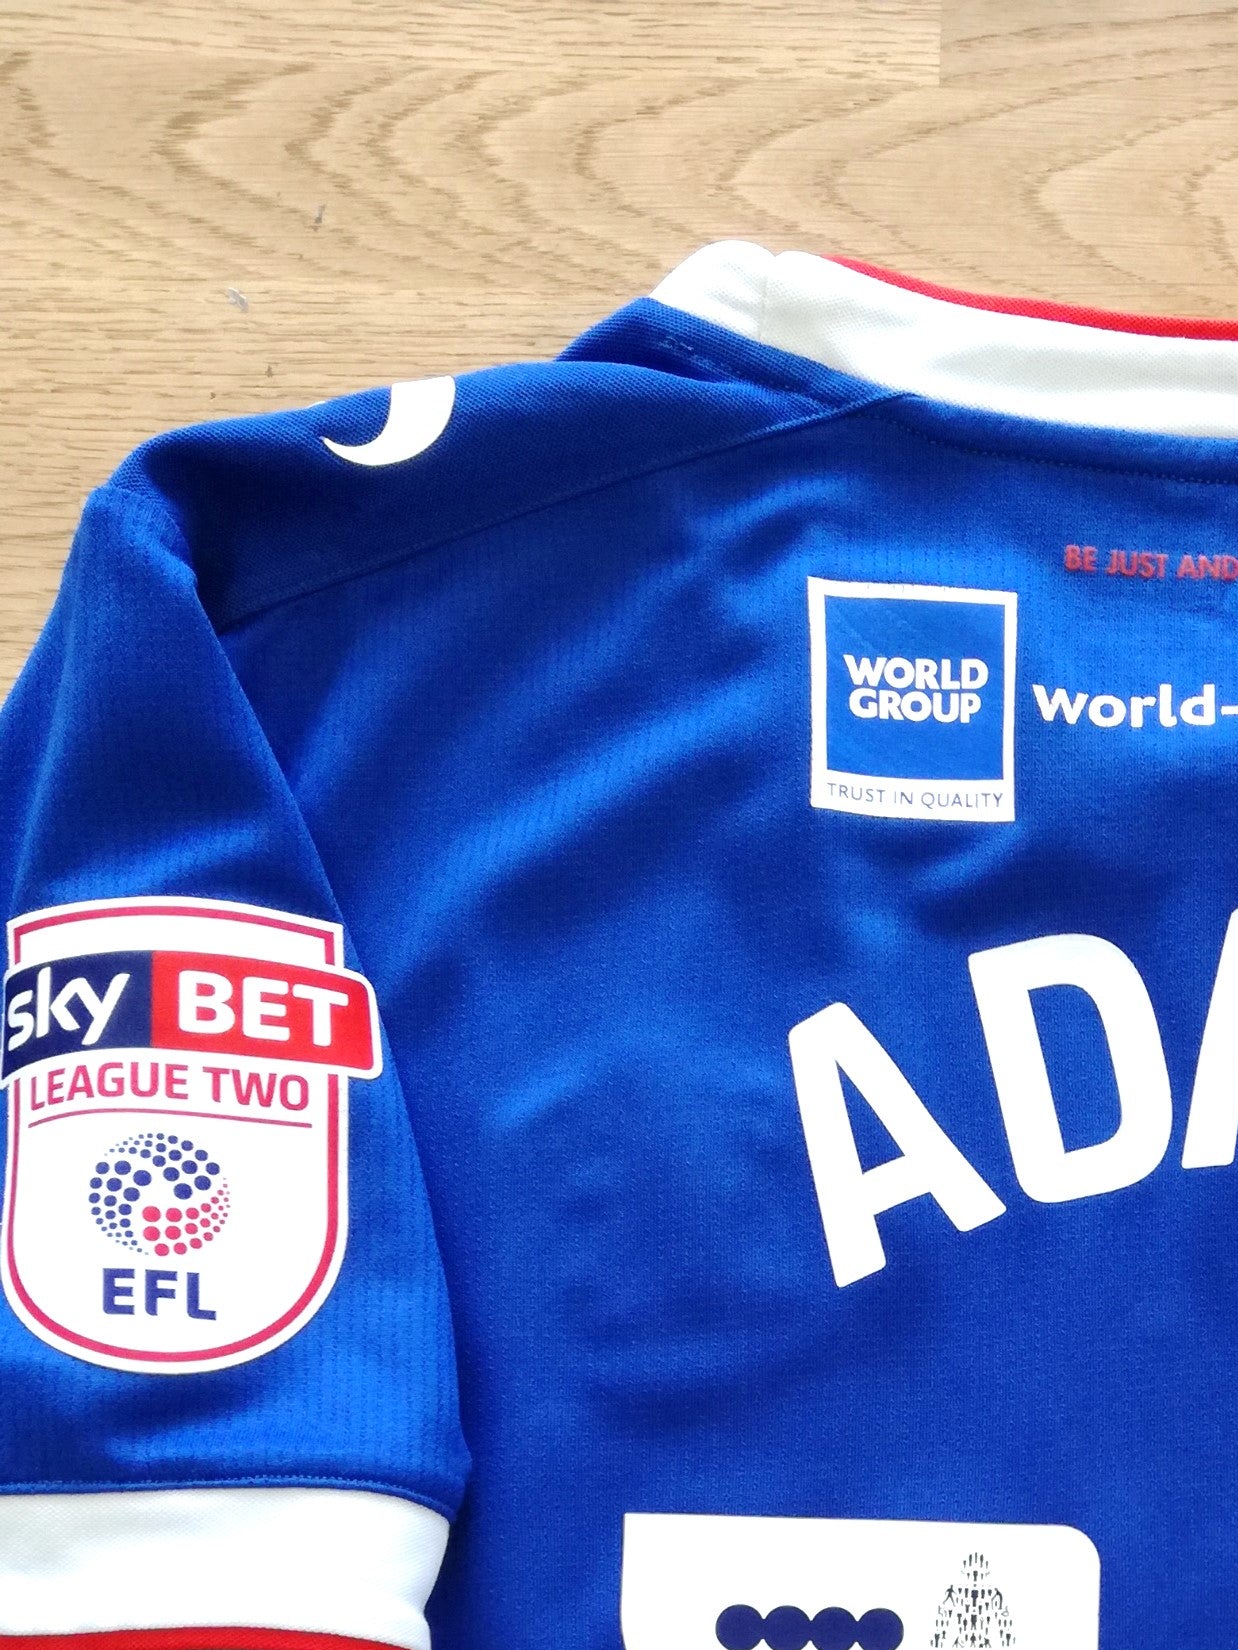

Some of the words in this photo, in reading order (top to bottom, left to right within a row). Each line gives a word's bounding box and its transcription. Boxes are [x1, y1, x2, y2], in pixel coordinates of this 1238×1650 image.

[1064, 543, 1098, 572] BE
[1106, 549, 1169, 579] JUST
[843, 654, 989, 690] WORLD
[849, 688, 982, 724] GROUP
[826, 782, 886, 803] TRUST
[893, 791, 914, 805] IN
[921, 791, 1004, 809] QUALITY
[7, 966, 131, 1052] sky
[177, 969, 350, 1048] BET
[29, 1061, 190, 1112] LEAGUE
[202, 1065, 310, 1112] TWO
[102, 1267, 217, 1321] EFL
